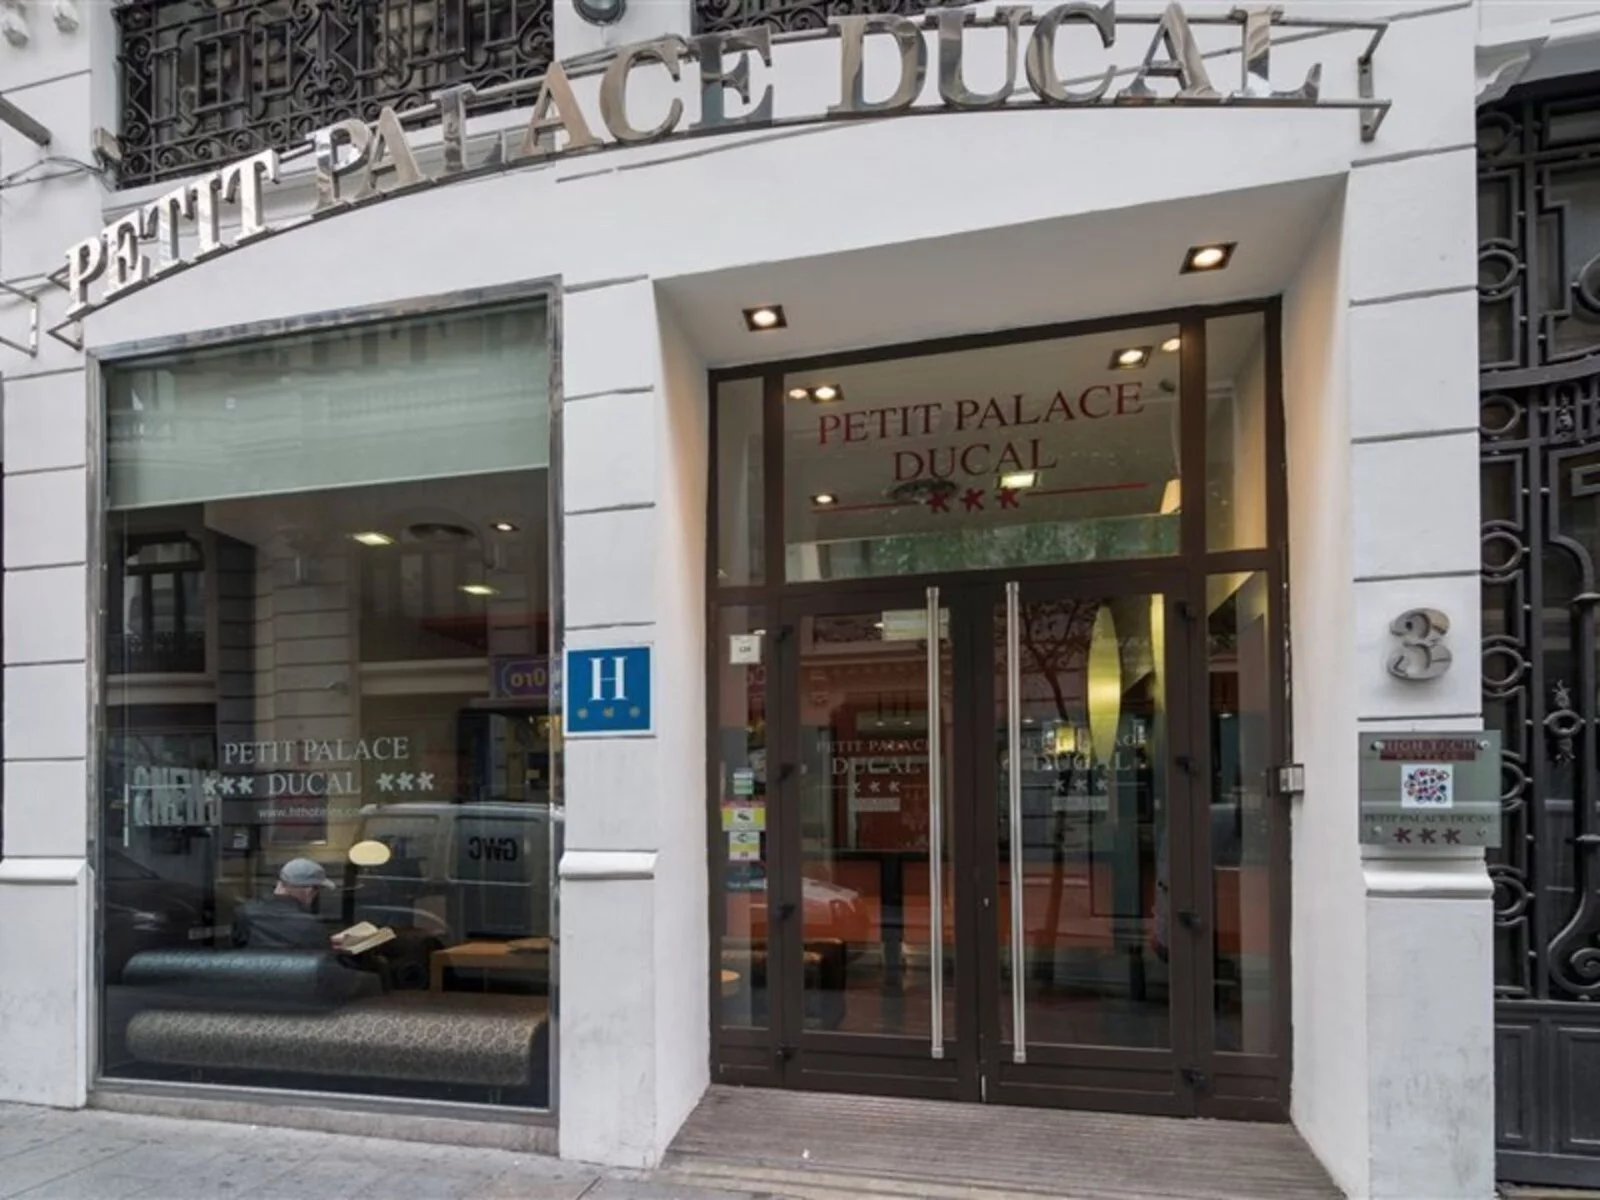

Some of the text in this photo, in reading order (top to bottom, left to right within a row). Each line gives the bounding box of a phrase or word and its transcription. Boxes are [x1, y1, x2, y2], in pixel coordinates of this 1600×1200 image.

[65, 1, 1322, 317] PETIT PALACE DUCAL
[818, 381, 1146, 445] PETIT PALACE
[893, 438, 1057, 481] DUCAL
[588, 655, 628, 701] H
[223, 736, 410, 765] PETIT PALACE
[832, 756, 921, 775] DUCAL
[267, 770, 362, 795] DUCAL
